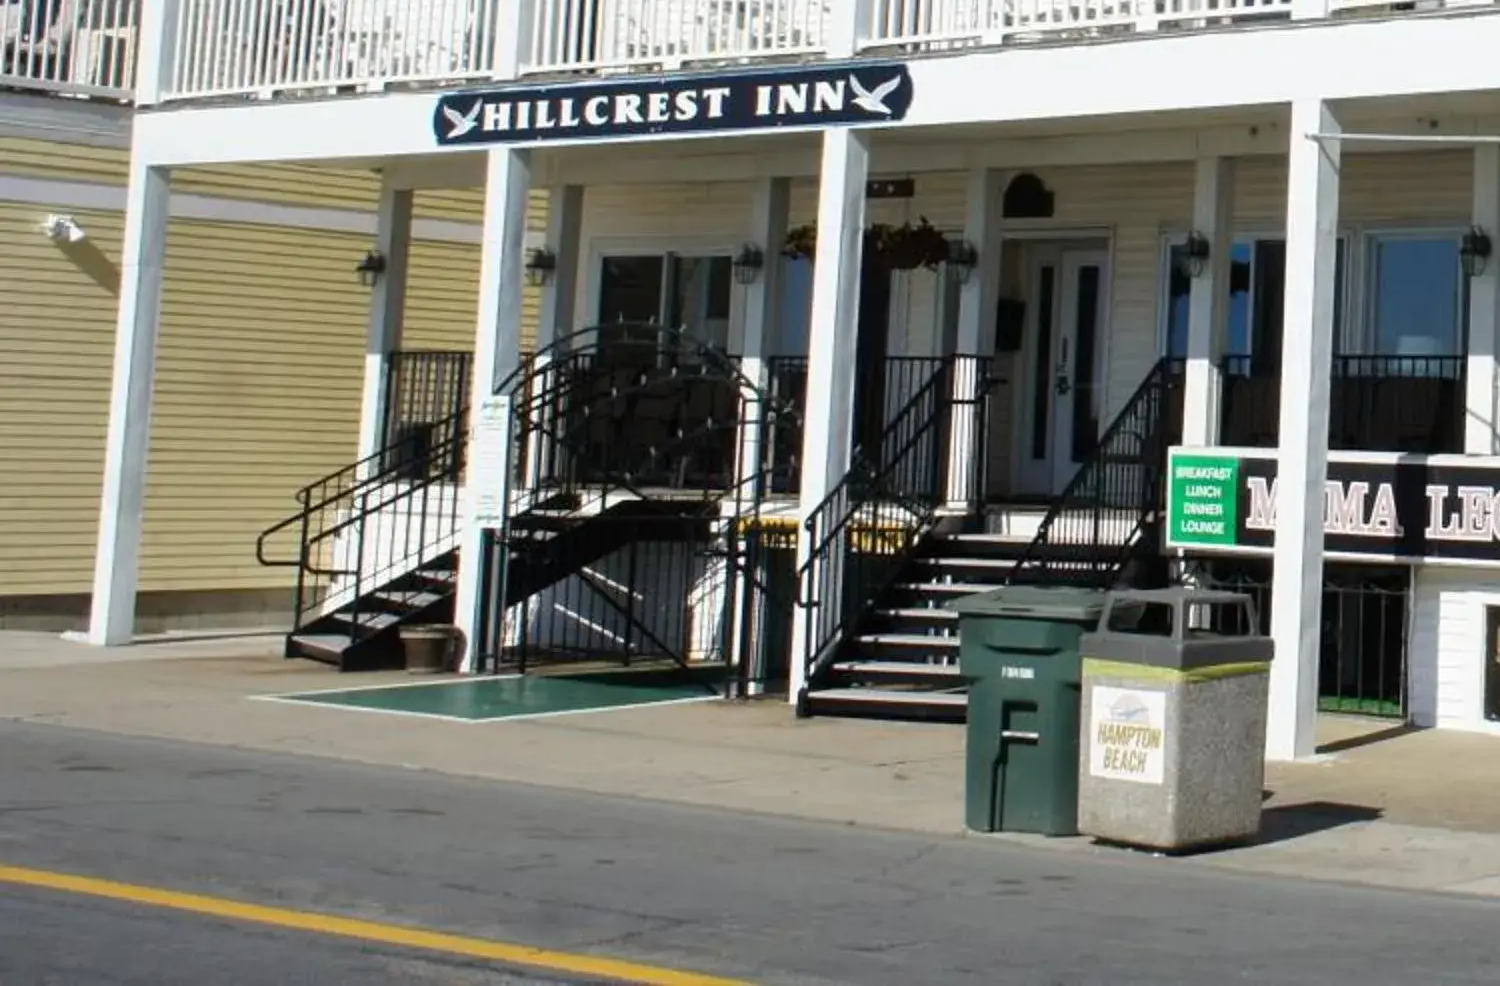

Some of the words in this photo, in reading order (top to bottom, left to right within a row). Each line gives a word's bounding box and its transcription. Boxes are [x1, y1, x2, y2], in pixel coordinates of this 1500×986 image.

[482, 87, 731, 132] HILLCREST
[755, 80, 847, 116] INN
[1175, 467, 1233, 481] BREAKFAST
[1185, 485, 1222, 499] LUNCH
[1183, 502, 1224, 516] DINNER
[1246, 476, 1404, 537] MMA
[1181, 519, 1225, 535] LOUNGE
[1097, 722, 1162, 749] HAMPTON
[1103, 745, 1148, 774] BEACH
